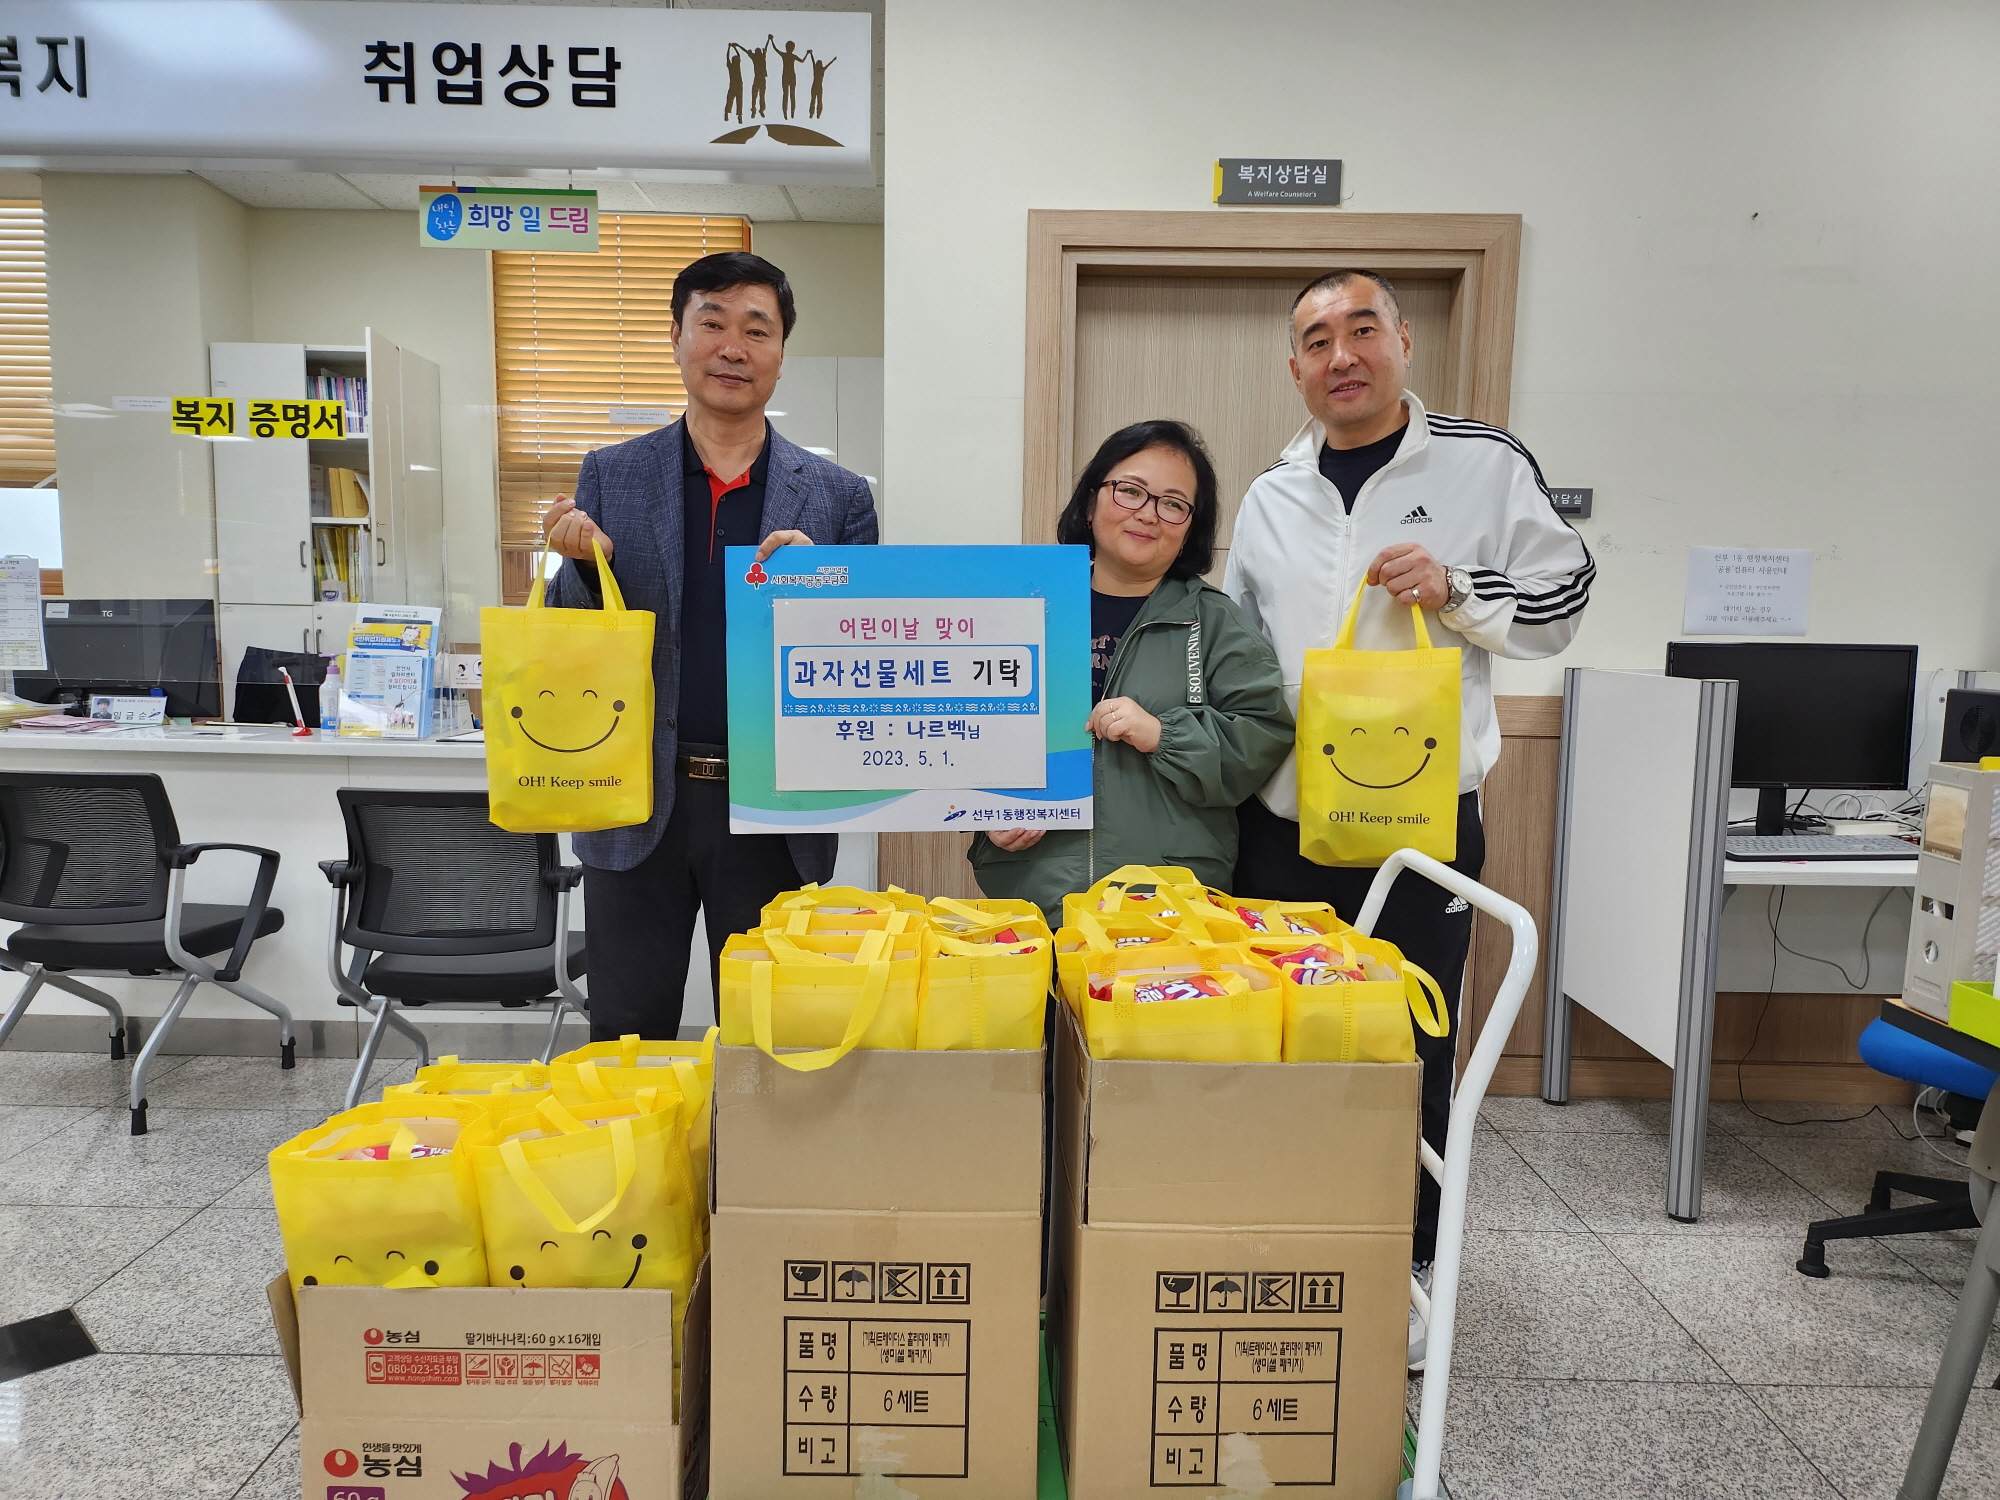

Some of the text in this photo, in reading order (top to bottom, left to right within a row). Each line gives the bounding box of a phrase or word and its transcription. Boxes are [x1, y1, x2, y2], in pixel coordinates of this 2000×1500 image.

[364, 40, 622, 108] 취업상담
[1238, 164, 1327, 184] 복지상담실
[467, 203, 589, 234] 희망 일 드림
[172, 400, 344, 439] 복지 증명서
[1400, 516, 1432, 525] adidas
[1747, 555, 1790, 563] 행정복지센터
[1758, 566, 1787, 575] 사용안내
[771, 575, 849, 588] 사회복지공동모금회
[101, 610, 113, 618] TG
[839, 617, 975, 640] 어린이날 맞이
[794, 659, 1021, 689] 과자선물세트 기탁
[836, 720, 875, 741] 후원
[907, 719, 980, 741] 나르벡님
[863, 750, 955, 767] 2023. 5. 1.
[518, 776, 622, 789] OH! Keep smile
[972, 807, 1081, 821] 선부1동행정복지센터
[1329, 811, 1430, 826] OH! Keep smile
[385, 1330, 420, 1344] 농심
[387, 1355, 412, 1363] 고객상담
[414, 1355, 445, 1363] 수신자요금
[387, 1364, 459, 1375] 080-023-5181
[388, 1375, 459, 1383] www.nongshim.com
[897, 1390, 929, 1413] 세트
[1266, 1398, 1298, 1421] 세트
[362, 1442, 422, 1453] 인생을 맛있게
[362, 1454, 423, 1478] 농심
